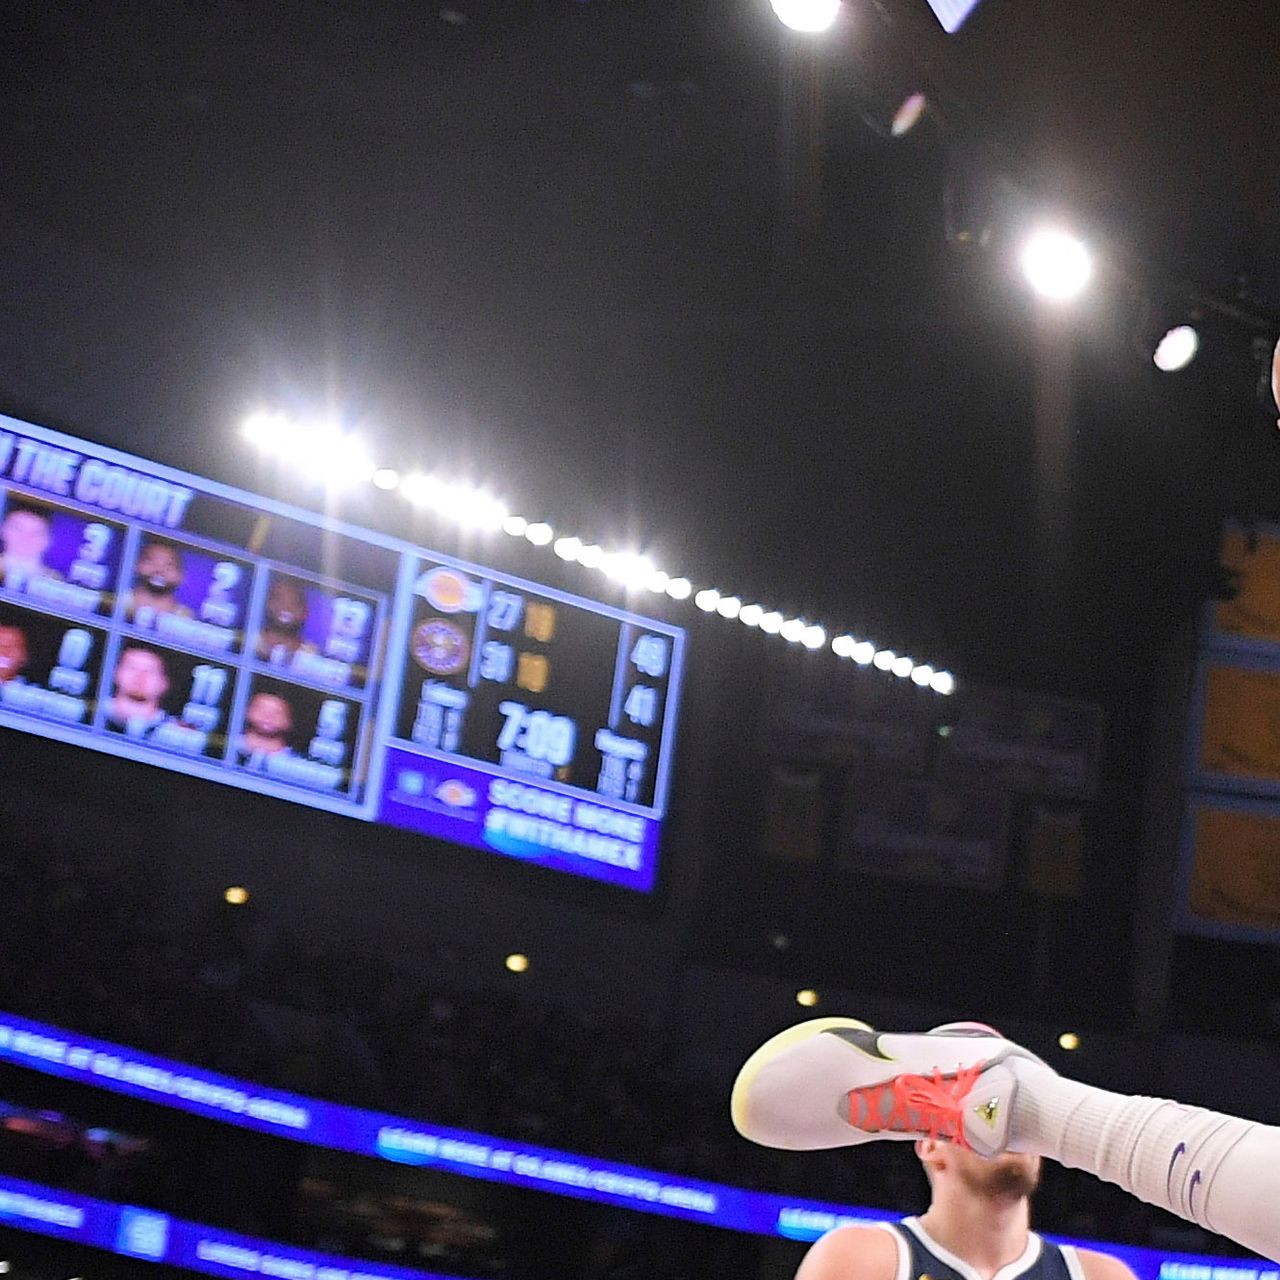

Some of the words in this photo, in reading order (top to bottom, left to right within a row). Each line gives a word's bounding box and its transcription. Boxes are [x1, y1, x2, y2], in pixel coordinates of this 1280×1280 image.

[75, 457, 193, 528] COURT
[488, 778, 573, 824] SCORE
[573, 801, 645, 844] MORE
